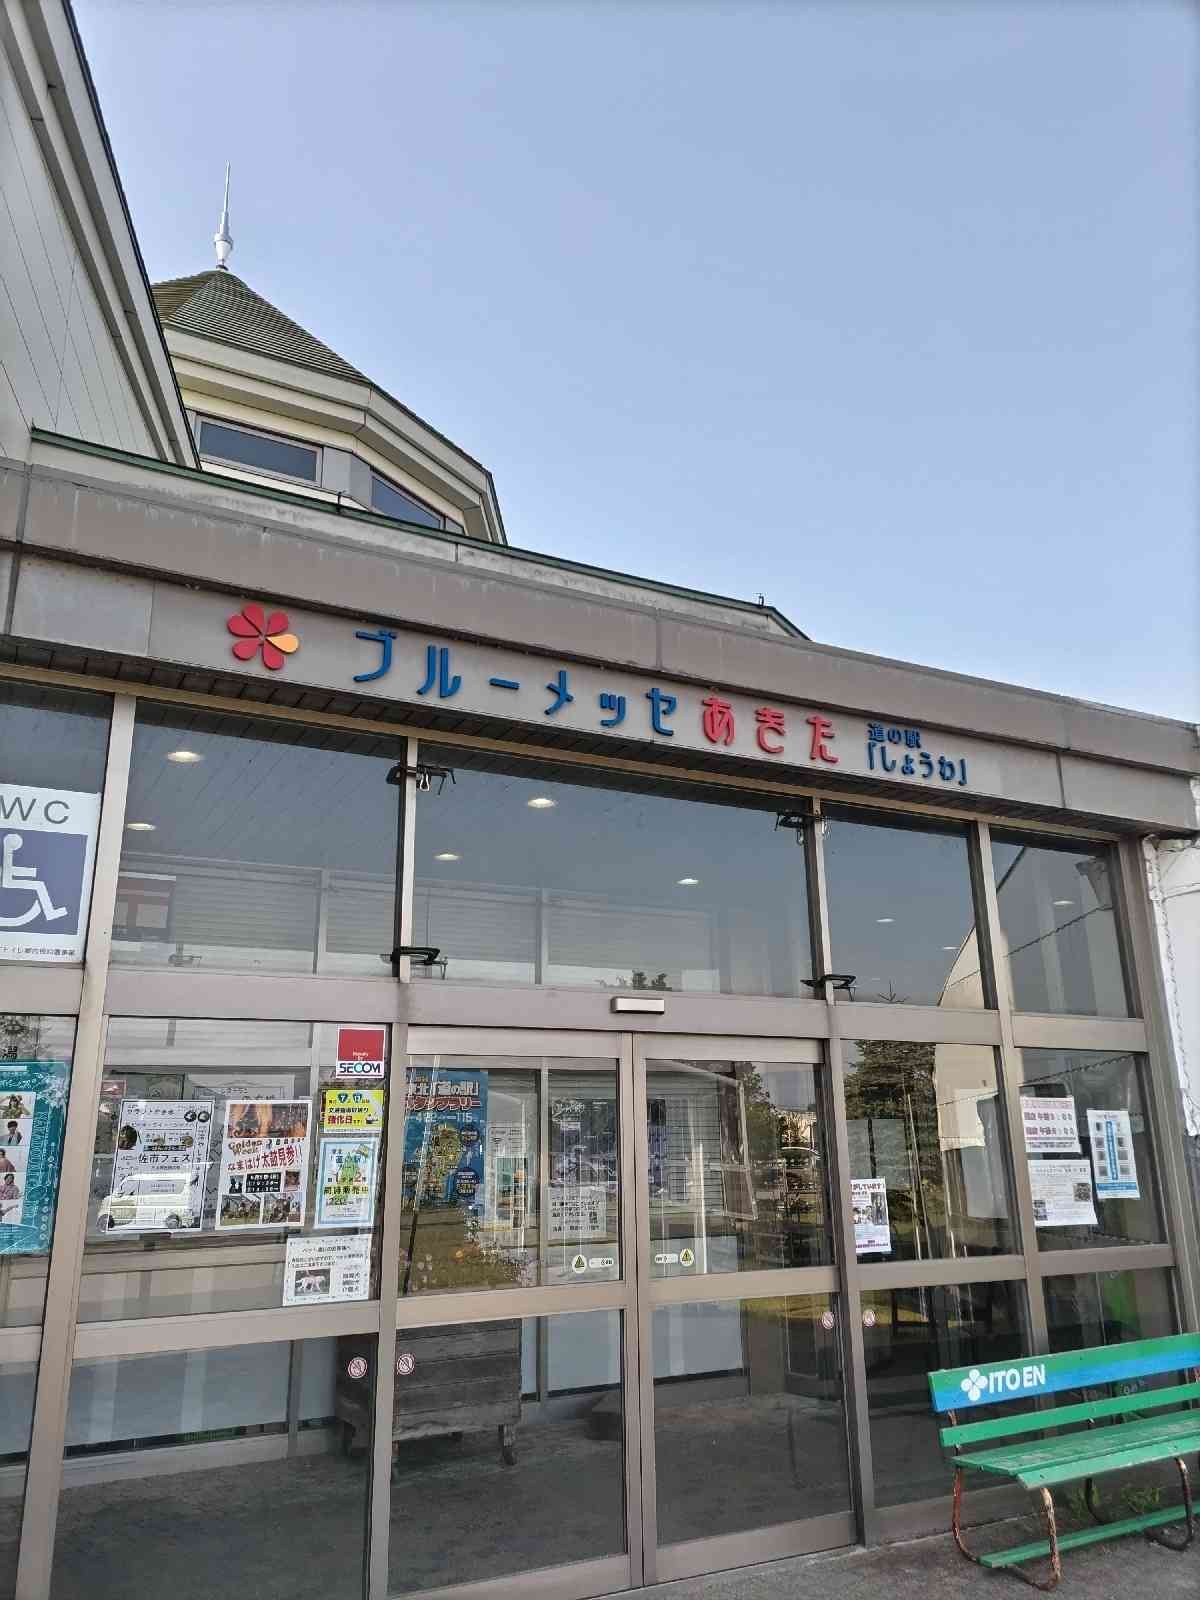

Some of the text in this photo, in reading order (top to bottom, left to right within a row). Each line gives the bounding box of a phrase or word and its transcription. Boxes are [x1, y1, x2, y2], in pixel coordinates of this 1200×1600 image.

[353, 630, 838, 764] ブルーメッセあきた
[867, 722, 921, 748] 道の駅
[867, 742, 968, 786] 「しょうわ」
[0, 795, 70, 824] WC
[340, 1062, 381, 1073] SECOM
[989, 1363, 1046, 1393] ITO EN
